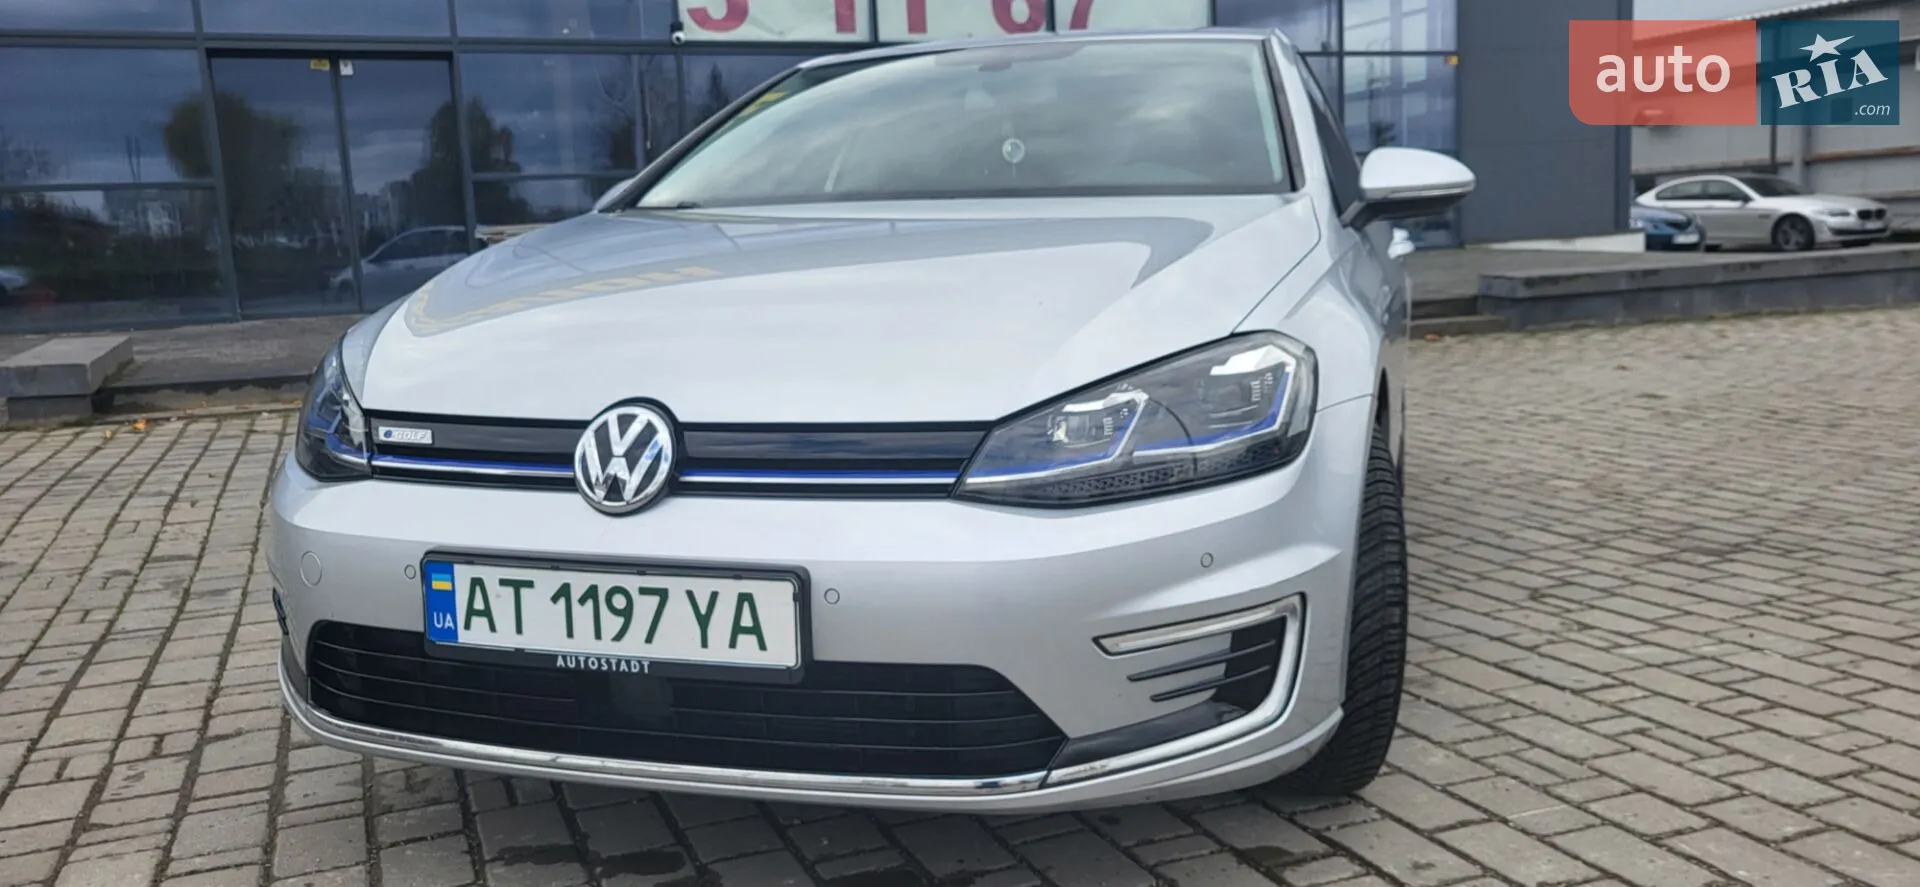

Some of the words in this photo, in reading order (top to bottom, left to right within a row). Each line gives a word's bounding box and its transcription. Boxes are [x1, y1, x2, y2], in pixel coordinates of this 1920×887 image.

[433, 611, 455, 630] UA
[463, 576, 535, 635] AT
[550, 582, 669, 645] 1197
[685, 589, 768, 652] YA
[556, 655, 650, 674] AUTOSTADT
